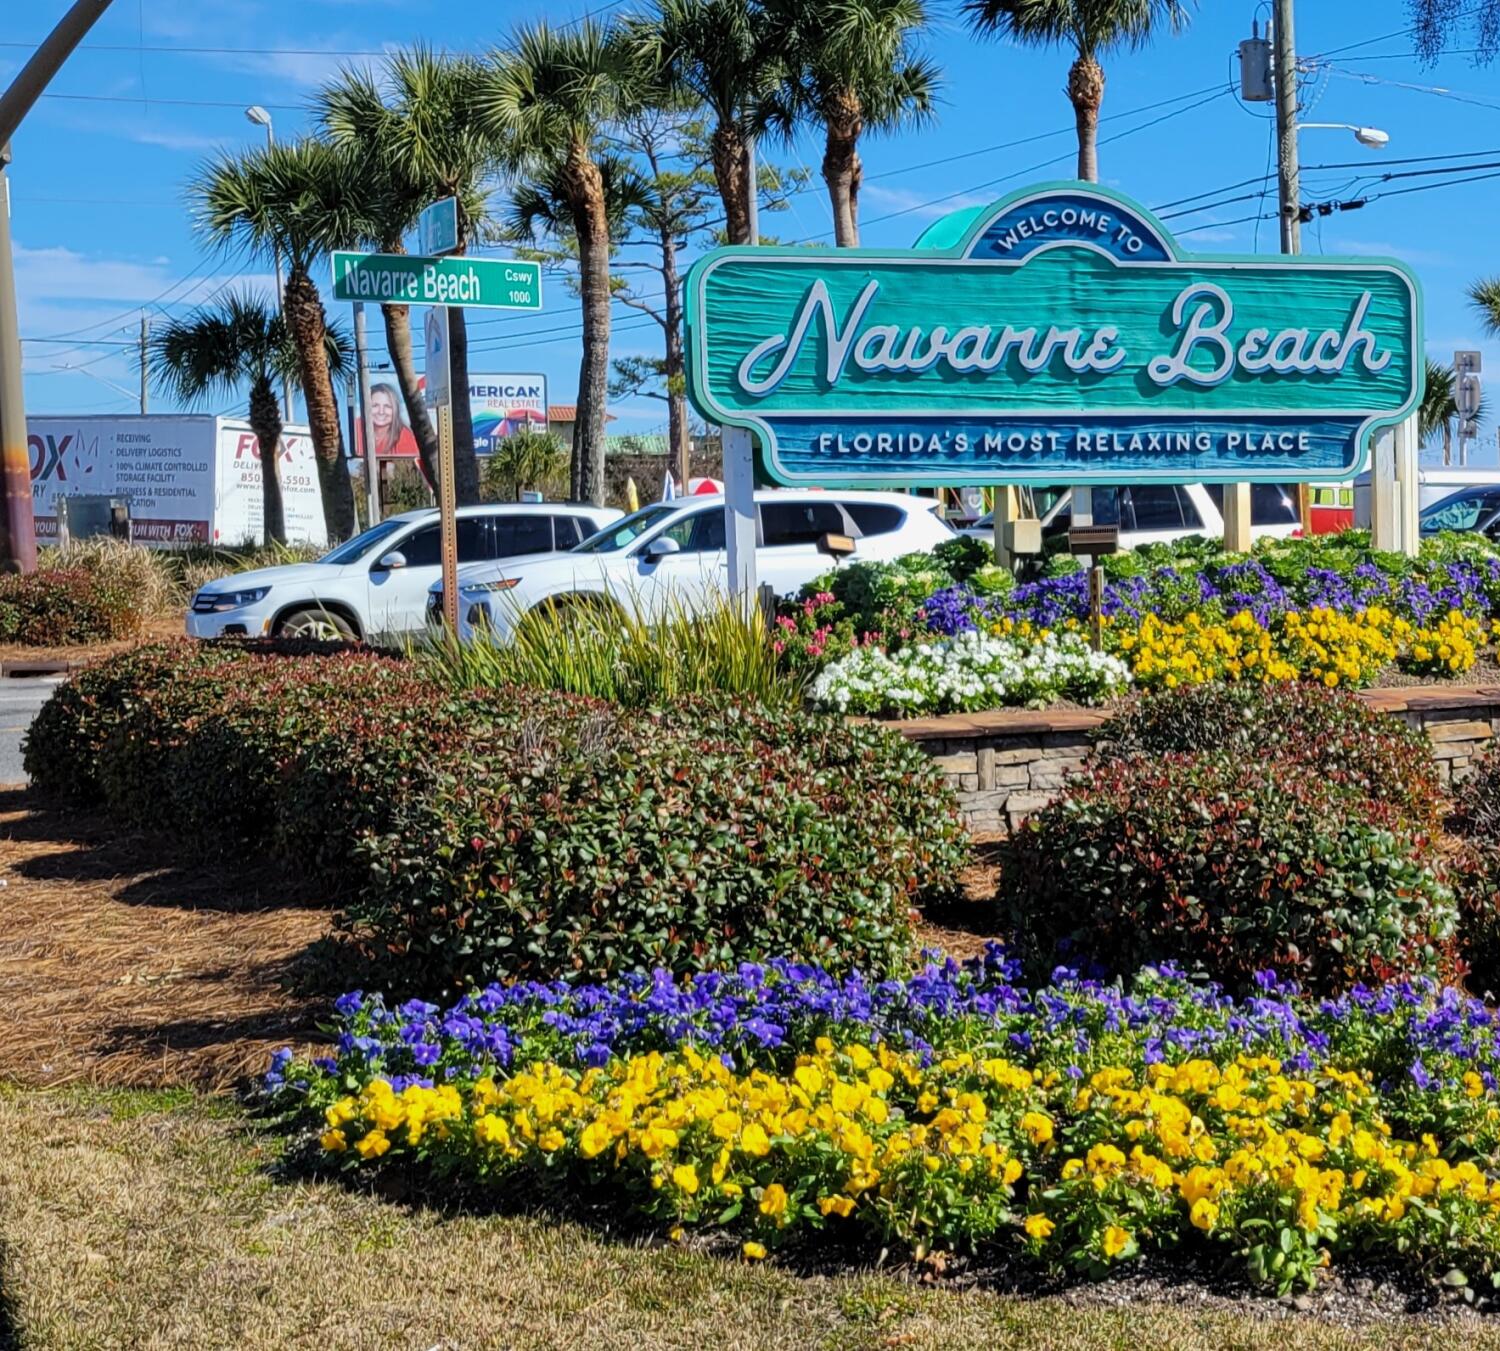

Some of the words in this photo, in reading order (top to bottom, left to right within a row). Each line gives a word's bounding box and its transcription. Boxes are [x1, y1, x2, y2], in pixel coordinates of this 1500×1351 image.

[998, 209, 1111, 250] WELCOME
[1117, 224, 1143, 252] TO
[345, 260, 418, 298] Navarre
[423, 264, 480, 300] Beach
[505, 269, 532, 284] Cswy
[508, 290, 530, 303] 1000
[738, 278, 1127, 397] Navarre
[1147, 282, 1392, 387] Beach
[469, 386, 540, 397] MERICAN
[488, 399, 507, 408] REAL
[511, 400, 541, 409] ESTATE
[116, 434, 151, 443] RECEIVING
[819, 431, 968, 453] FLORIDA'S
[984, 432, 1060, 452] MOST
[1076, 432, 1212, 452] RELAXING
[1227, 432, 1311, 451] PLACE
[27, 434, 73, 481] OX
[116, 448, 146, 457] DELIVERY
[148, 448, 182, 457] LOGISTICS
[116, 462, 134, 471] 100%
[135, 462, 162, 471] CLIMATE
[164, 462, 208, 472] CONTROLLED
[233, 461, 263, 470] DELIV
[116, 473, 145, 482] STORAGE
[147, 473, 175, 482] FACILITY
[154, 488, 196, 497] RESIDENTIAL
[148, 525, 171, 537] WITH
